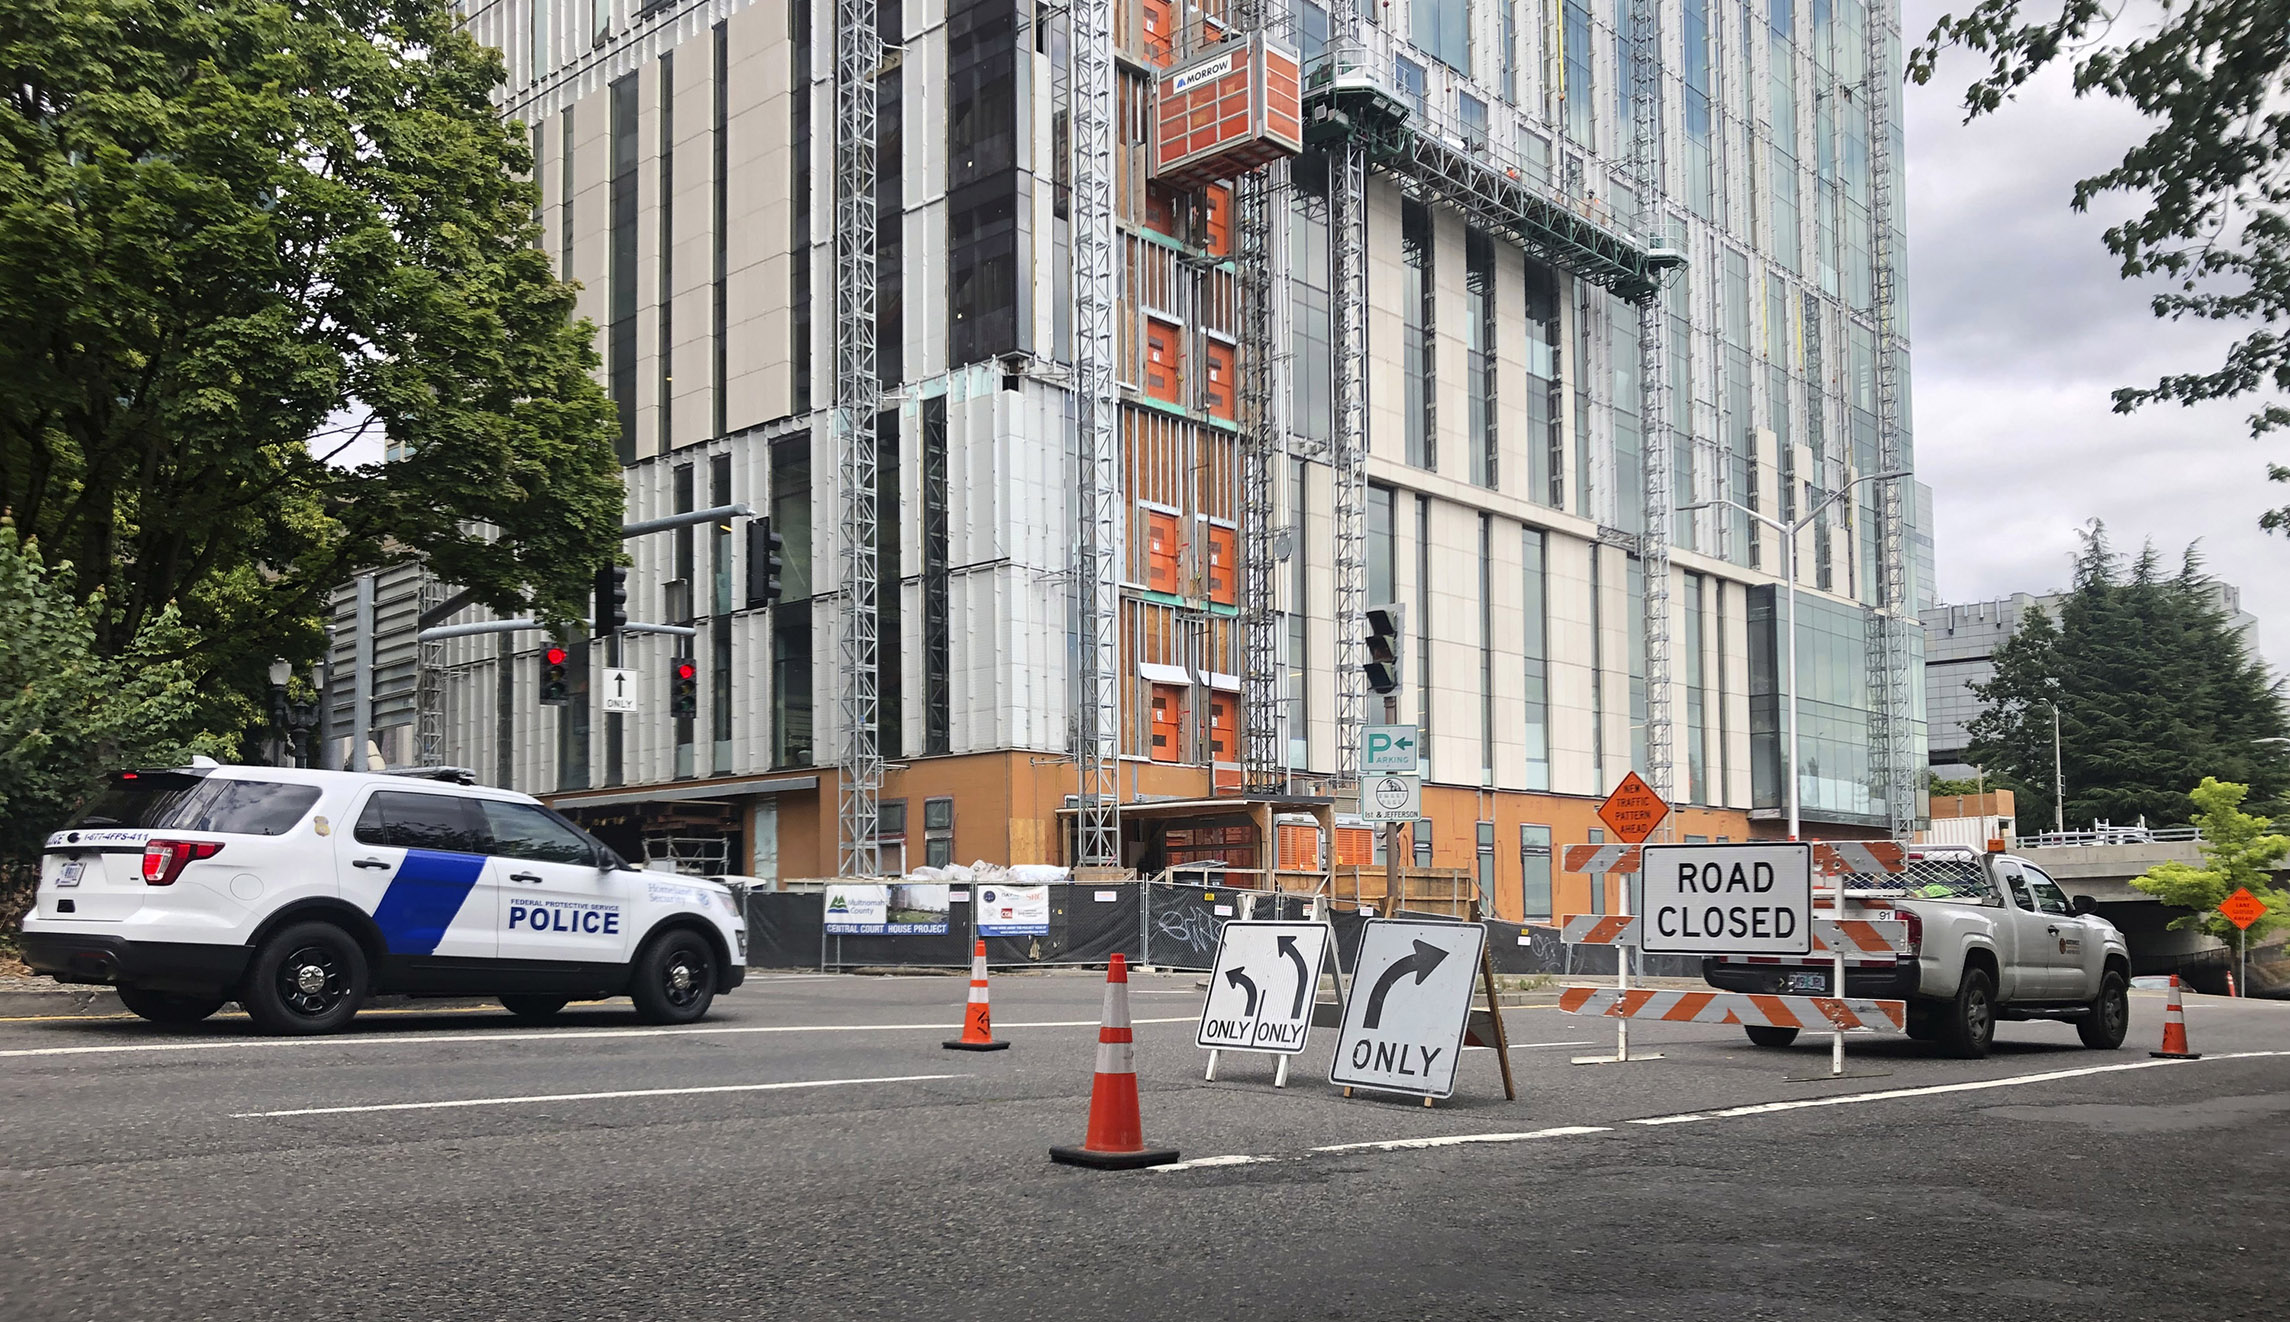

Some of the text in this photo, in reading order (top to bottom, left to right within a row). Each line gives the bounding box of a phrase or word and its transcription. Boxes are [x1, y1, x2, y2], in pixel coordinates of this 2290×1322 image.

[1187, 60, 1228, 83] MORROW
[607, 699, 633, 708] ONLY
[1624, 784, 1640, 793] NEW
[1616, 797, 1649, 807] TRAFFIC
[1615, 811, 1650, 821] PATTERN
[1620, 824, 1647, 833] AHEAD
[1678, 862, 1774, 893] ROAD
[510, 899, 543, 907] FEDERAL
[545, 901, 589, 910] PROTECTIVE
[848, 899, 885, 907] Multnomah
[850, 907, 874, 915] County
[1879, 911, 1890, 920] 91
[509, 907, 619, 934] POLICE
[1658, 906, 1796, 938] CLOSED
[826, 924, 947, 934] CENTRAL COURT HOUSE PROJECT
[1207, 1019, 1303, 1043] ONLY ONLY
[1352, 1039, 1442, 1077] ONLY
